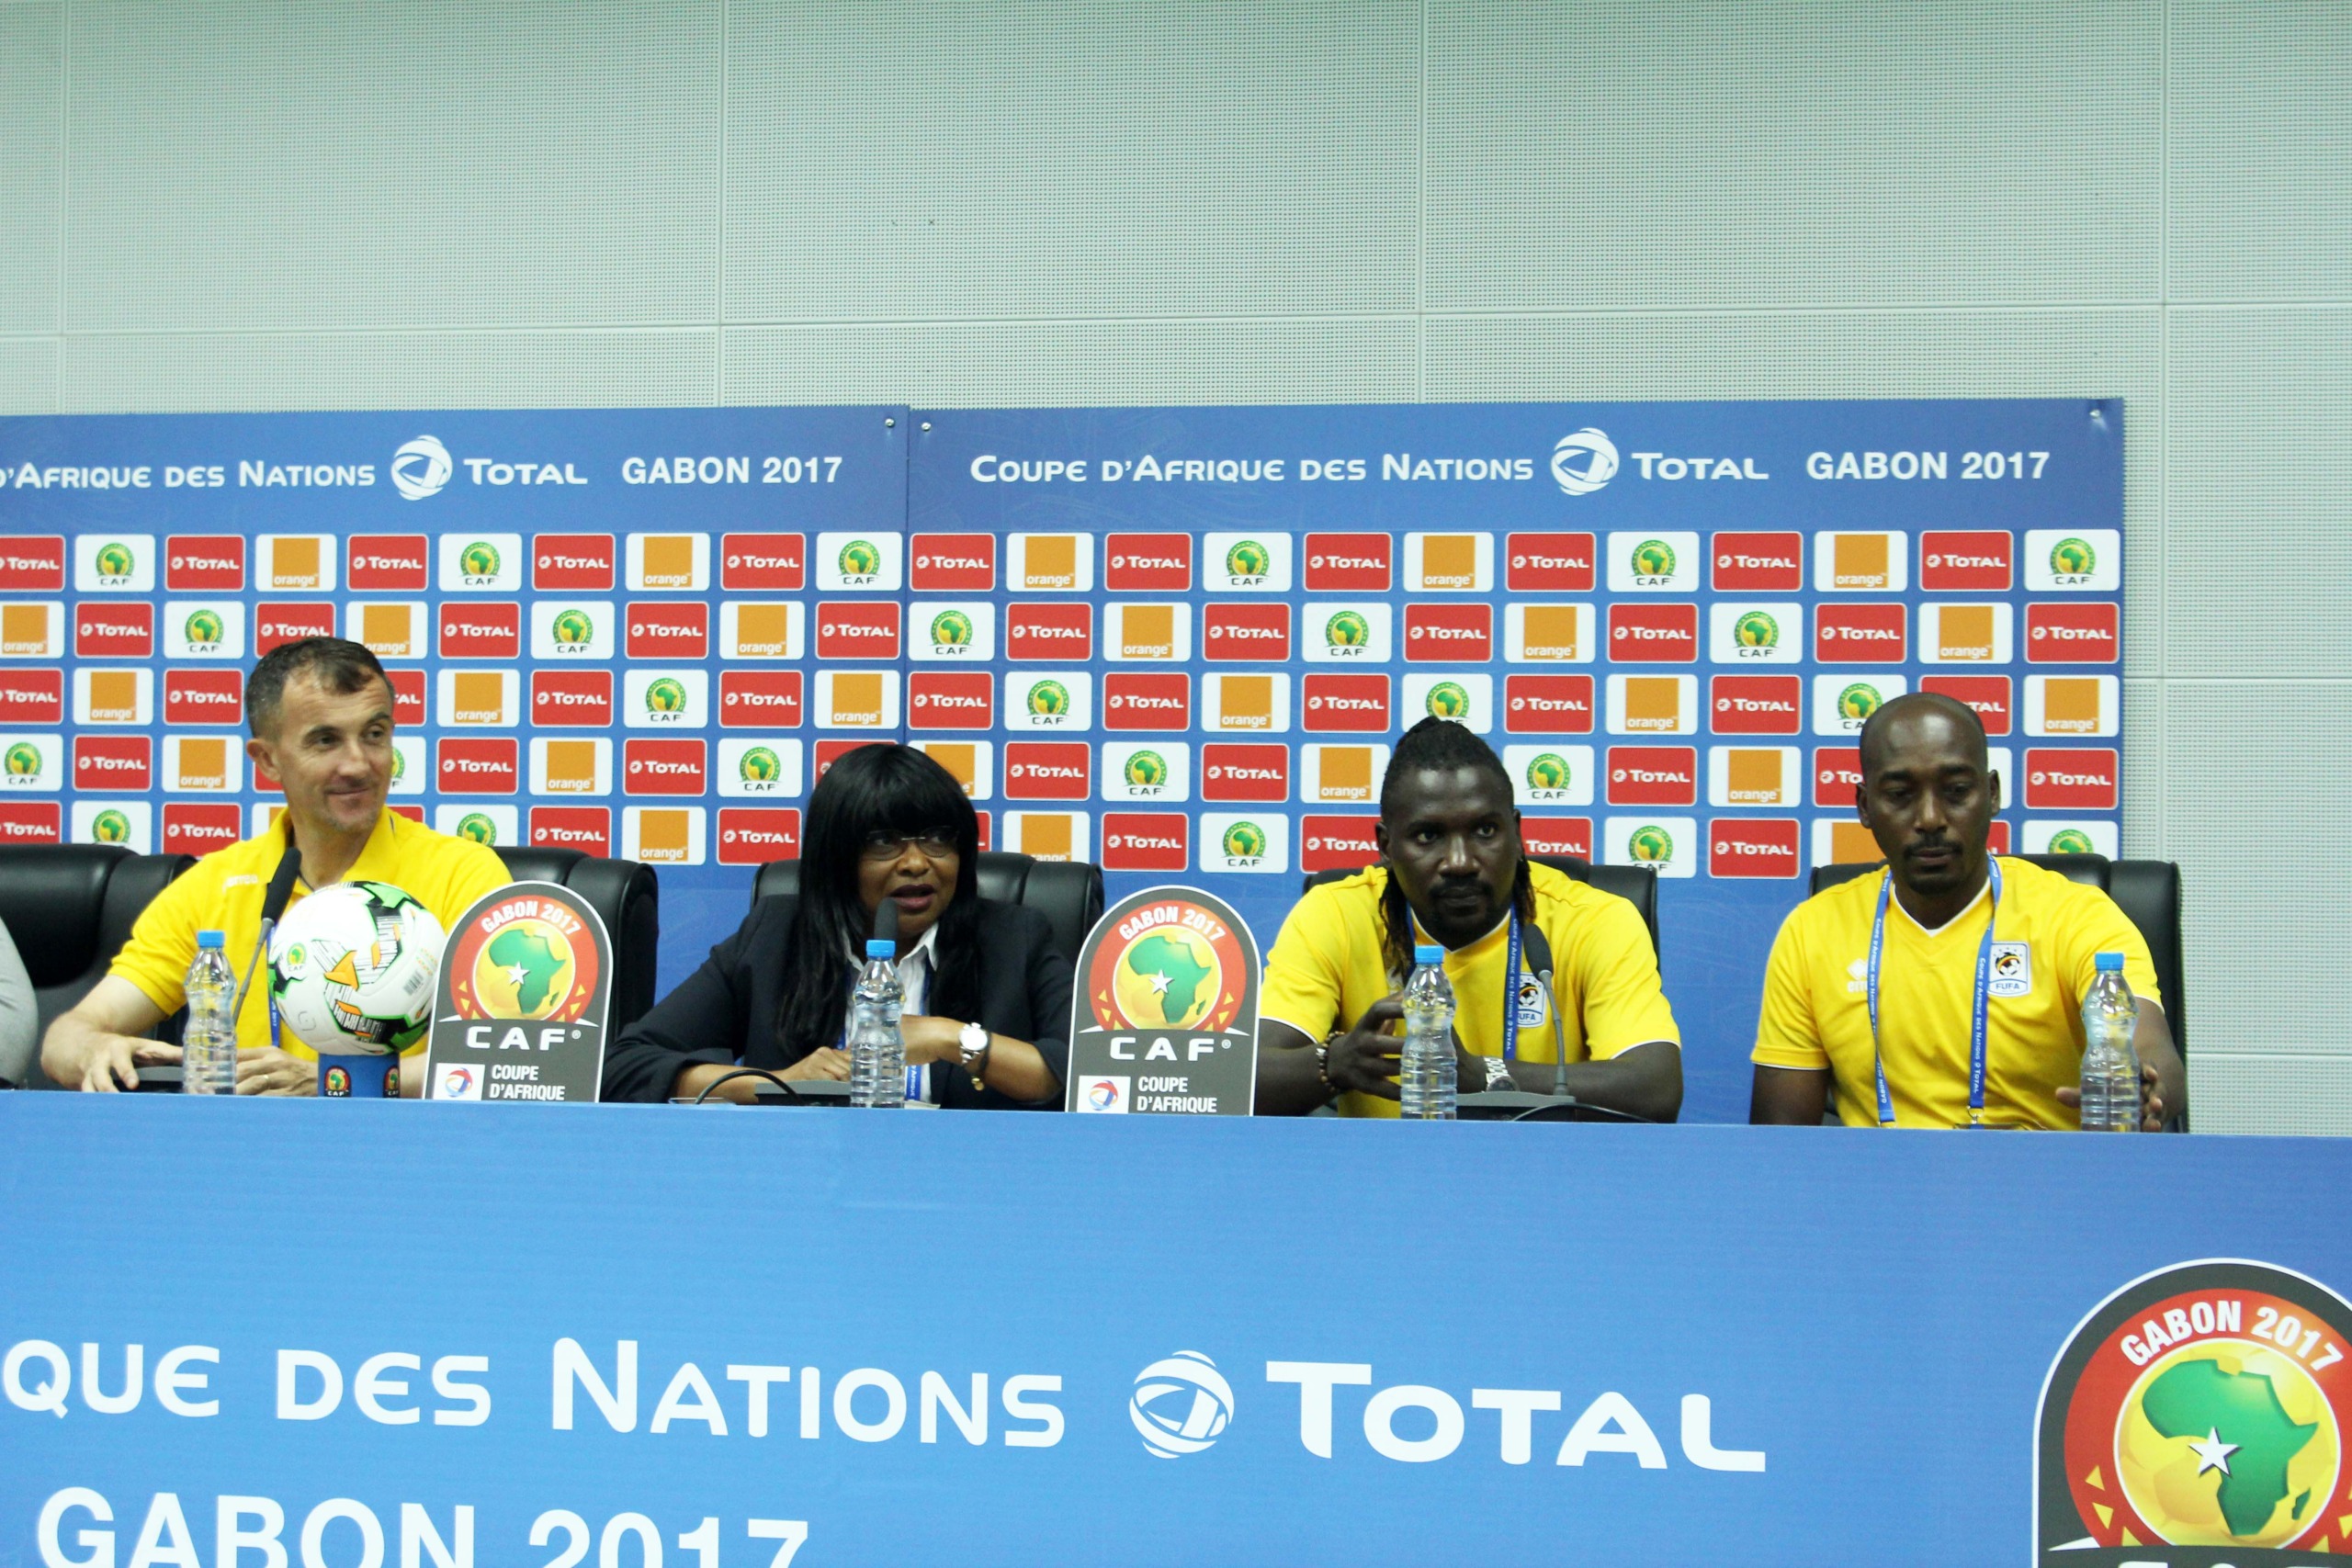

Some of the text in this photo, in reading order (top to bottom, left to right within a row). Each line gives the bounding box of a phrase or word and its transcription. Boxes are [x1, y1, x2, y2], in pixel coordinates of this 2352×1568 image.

[165, 467, 224, 488] DES
[240, 462, 375, 487] NATIONS
[463, 459, 588, 485] TOTAL
[622, 457, 750, 484] GABON
[763, 457, 842, 483] 2017
[971, 452, 2050, 483] COUPE D'AFRIQUE DES NATIONS TOTAL GABON 2017
[7, 558, 59, 570] TOTAL
[186, 557, 239, 570] TOTAL
[368, 557, 422, 569] TOTAL
[554, 556, 609, 569] TOTAL
[743, 556, 799, 568] TOTAL
[932, 556, 989, 569] TOTAL
[1127, 556, 1185, 568] TOTAL
[1327, 556, 1385, 568] TOTAL
[1529, 556, 1589, 568] TOTAL
[1735, 556, 1796, 568] TOTAL
[1943, 555, 2006, 567] TOTAL
[274, 575, 315, 588] orange
[465, 578, 495, 586] CAF
[644, 574, 688, 587] orange
[843, 577, 875, 585] CAF
[1026, 574, 1069, 587] orange
[1231, 578, 1263, 586] CAF
[1425, 574, 1470, 587] orange
[1637, 578, 1669, 586] CAF
[1837, 573, 1883, 587] orange
[2055, 577, 2089, 585] CAF
[95, 624, 148, 636] TOTAL
[276, 624, 329, 637] TOTAL
[459, 624, 514, 637] TOTAL
[647, 624, 703, 637] TOTAL
[838, 625, 894, 637] TOTAL
[1028, 626, 1086, 637] TOTAL
[1226, 626, 1284, 638] TOTAL
[1426, 626, 1487, 639] TOTAL
[1631, 626, 1691, 639] TOTAL
[1838, 627, 1900, 639] TOTAL
[2049, 626, 2112, 639] TOTAL
[3, 640, 44, 653] orange
[740, 641, 783, 655] orange
[1124, 643, 1168, 657] orange
[1330, 649, 1363, 657] CAF
[1526, 645, 1571, 658] orange
[1940, 645, 1987, 659] orange
[1739, 649, 1772, 658] CAF
[6, 690, 57, 703] TOTAL
[185, 691, 237, 703] TOTAL
[552, 692, 606, 705] TOTAL
[741, 693, 797, 705] TOTAL
[930, 694, 987, 707] TOTAL
[1125, 695, 1183, 708] TOTAL
[1325, 696, 1384, 709] TOTAL
[1527, 698, 1588, 710] TOTAL
[1733, 698, 1794, 711] TOTAL
[92, 707, 133, 721] orange
[456, 709, 499, 724] orange
[833, 711, 876, 725] orange
[1222, 714, 1266, 728] orange
[1627, 716, 1673, 729] orange
[2046, 718, 2093, 731] orange
[94, 757, 146, 770] TOTAL
[458, 760, 513, 772] TOTAL
[645, 761, 700, 773] TOTAL
[1026, 764, 1084, 777] TOTAL
[1224, 766, 1283, 779] TOTAL
[1629, 770, 1690, 783] TOTAL
[180, 774, 221, 788] orange
[548, 778, 592, 791] orange
[2048, 773, 2111, 785] TOTAL
[1129, 787, 1161, 795] CAF
[1321, 785, 1367, 798] orange
[1532, 792, 1565, 800] CAF
[1730, 789, 1777, 803] orange
[4, 822, 55, 835] TOTAL
[182, 824, 235, 837] TOTAL
[550, 829, 605, 841] TOTAL
[739, 830, 795, 843] TOTAL
[1124, 835, 1182, 848] TOTAL
[1526, 840, 1586, 852] TOTAL
[1732, 841, 1793, 855] TOTAL
[641, 847, 685, 860] orange
[1030, 853, 1063, 862] range
[1227, 859, 1260, 867] CAF
[481, 900, 581, 935] GABON 2017
[1119, 906, 1226, 942] GABON 2017
[492, 1065, 538, 1080] COUPE
[1138, 1077, 1188, 1092] COUPE
[1973, 1069, 1981, 1093] TOTAL
[490, 1084, 565, 1100] D'AFRIQUE
[1137, 1096, 1217, 1112] D'AFRIQUE
[2120, 1301, 2344, 1371] GABON 2017
[277, 1349, 492, 1427] DES
[552, 1337, 1065, 1448] NATIONS
[1266, 1360, 1766, 1472] TOTAL
[38, 1486, 475, 1568] GABON
